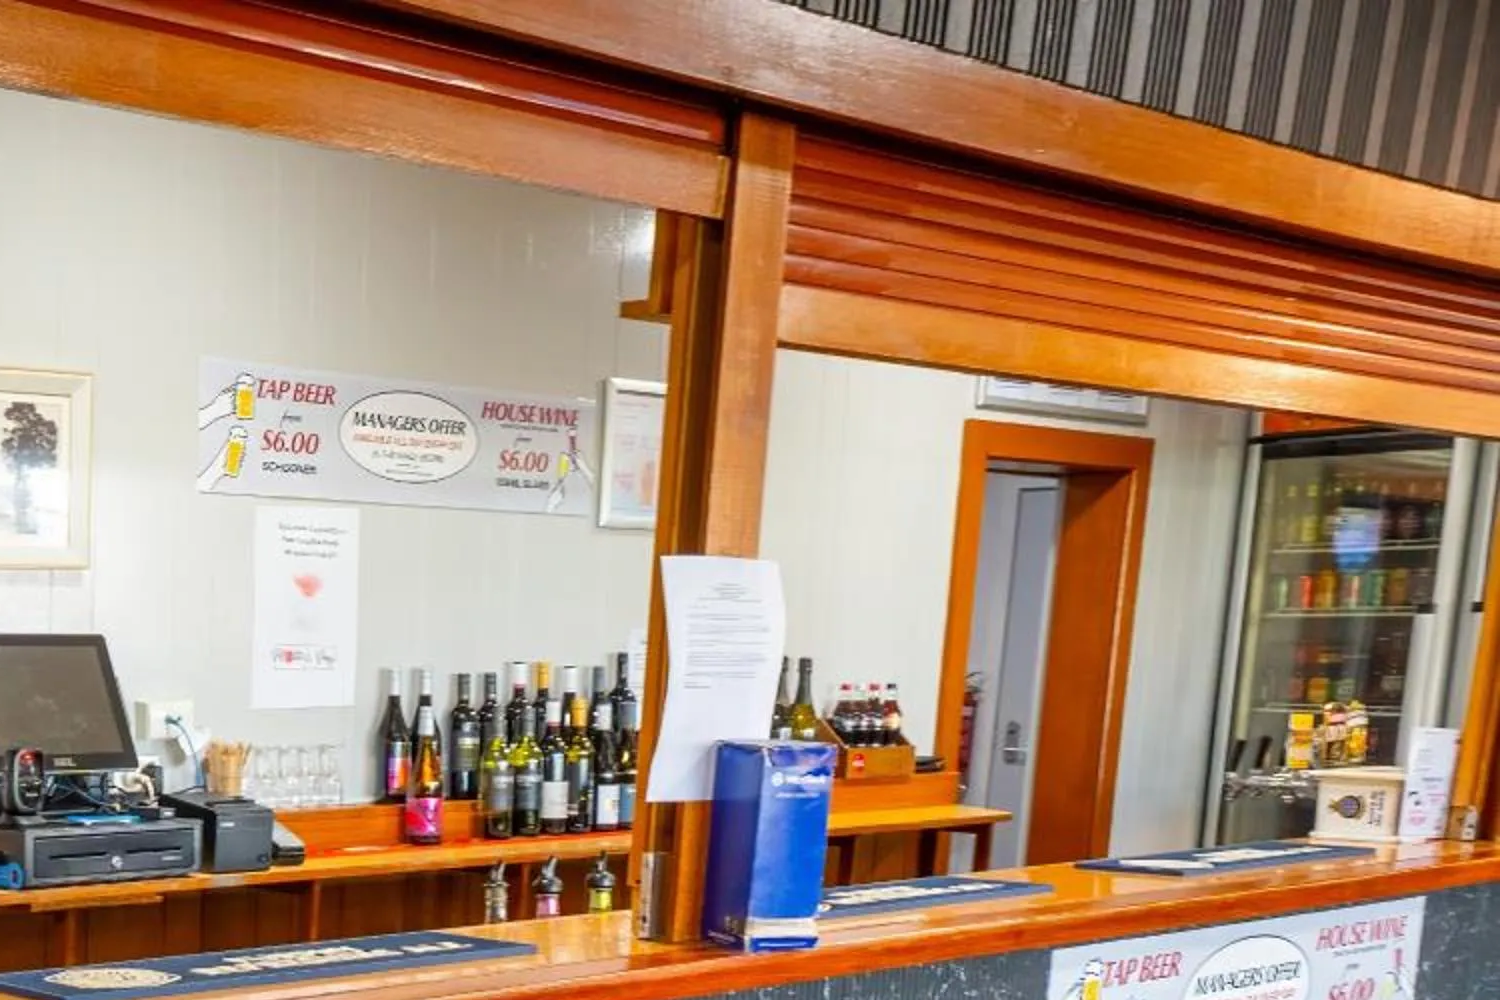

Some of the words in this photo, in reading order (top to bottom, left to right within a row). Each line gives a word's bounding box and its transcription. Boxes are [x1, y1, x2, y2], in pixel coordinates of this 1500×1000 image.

[257, 379, 290, 401] TAP
[293, 383, 337, 405] BEER
[352, 411, 426, 432] MANAGERS
[428, 419, 467, 436] OFFER
[481, 401, 536, 422] HOUSE
[539, 407, 580, 426] WINE
[260, 429, 320, 455] $6.00
[498, 449, 550, 473] $6.00
[1102, 957, 1139, 988] TAP
[1138, 951, 1183, 983] BEER
